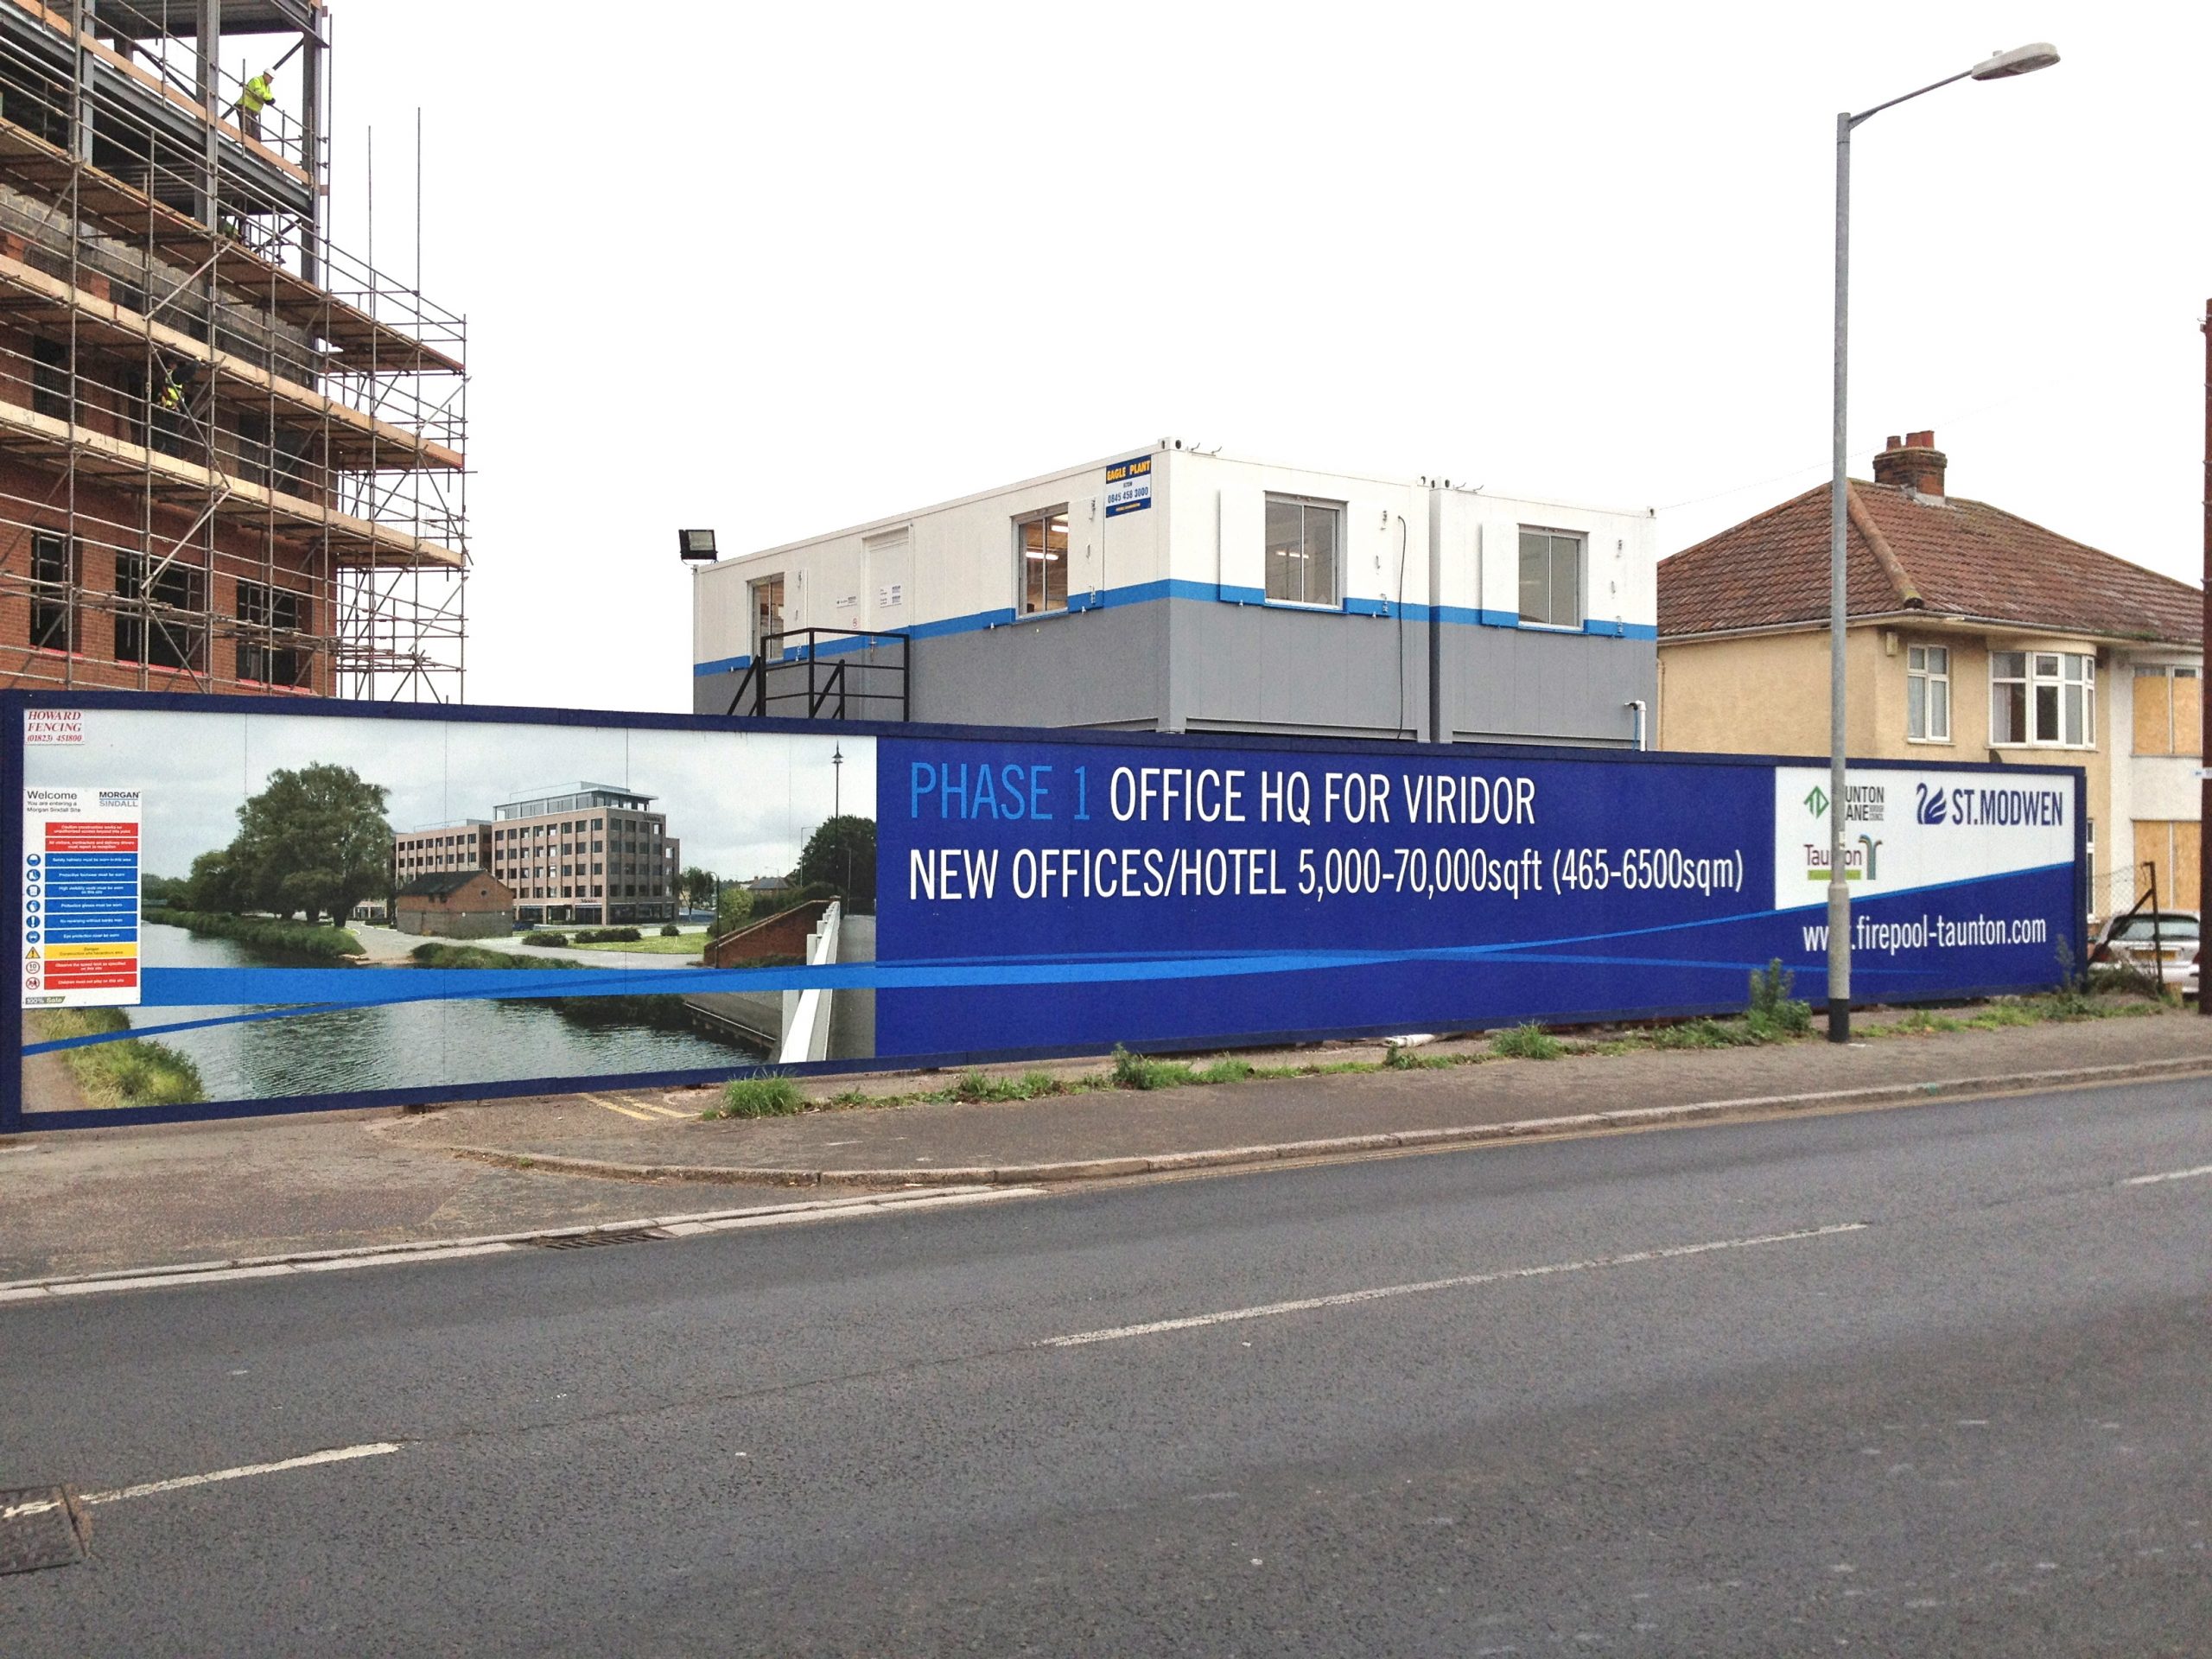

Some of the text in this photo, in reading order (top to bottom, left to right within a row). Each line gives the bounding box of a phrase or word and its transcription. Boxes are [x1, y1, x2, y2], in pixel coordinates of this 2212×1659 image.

[1107, 461, 1151, 480] EAGLE PLANT
[29, 711, 81, 720] HOWARD
[28, 722, 82, 732] FENCING
[27, 791, 77, 799] Welcome
[911, 762, 1535, 826] PHASE 1 OFFICE HQ FOR VIRIDOR
[1846, 786, 1884, 803] UNTON
[1952, 789, 2063, 826] ST.MODWEN
[1803, 844, 1862, 865] Tauon
[910, 848, 1743, 902] NEW OFFICES/HOTEL 5,000-70,000sqft (465-6500sqm)
